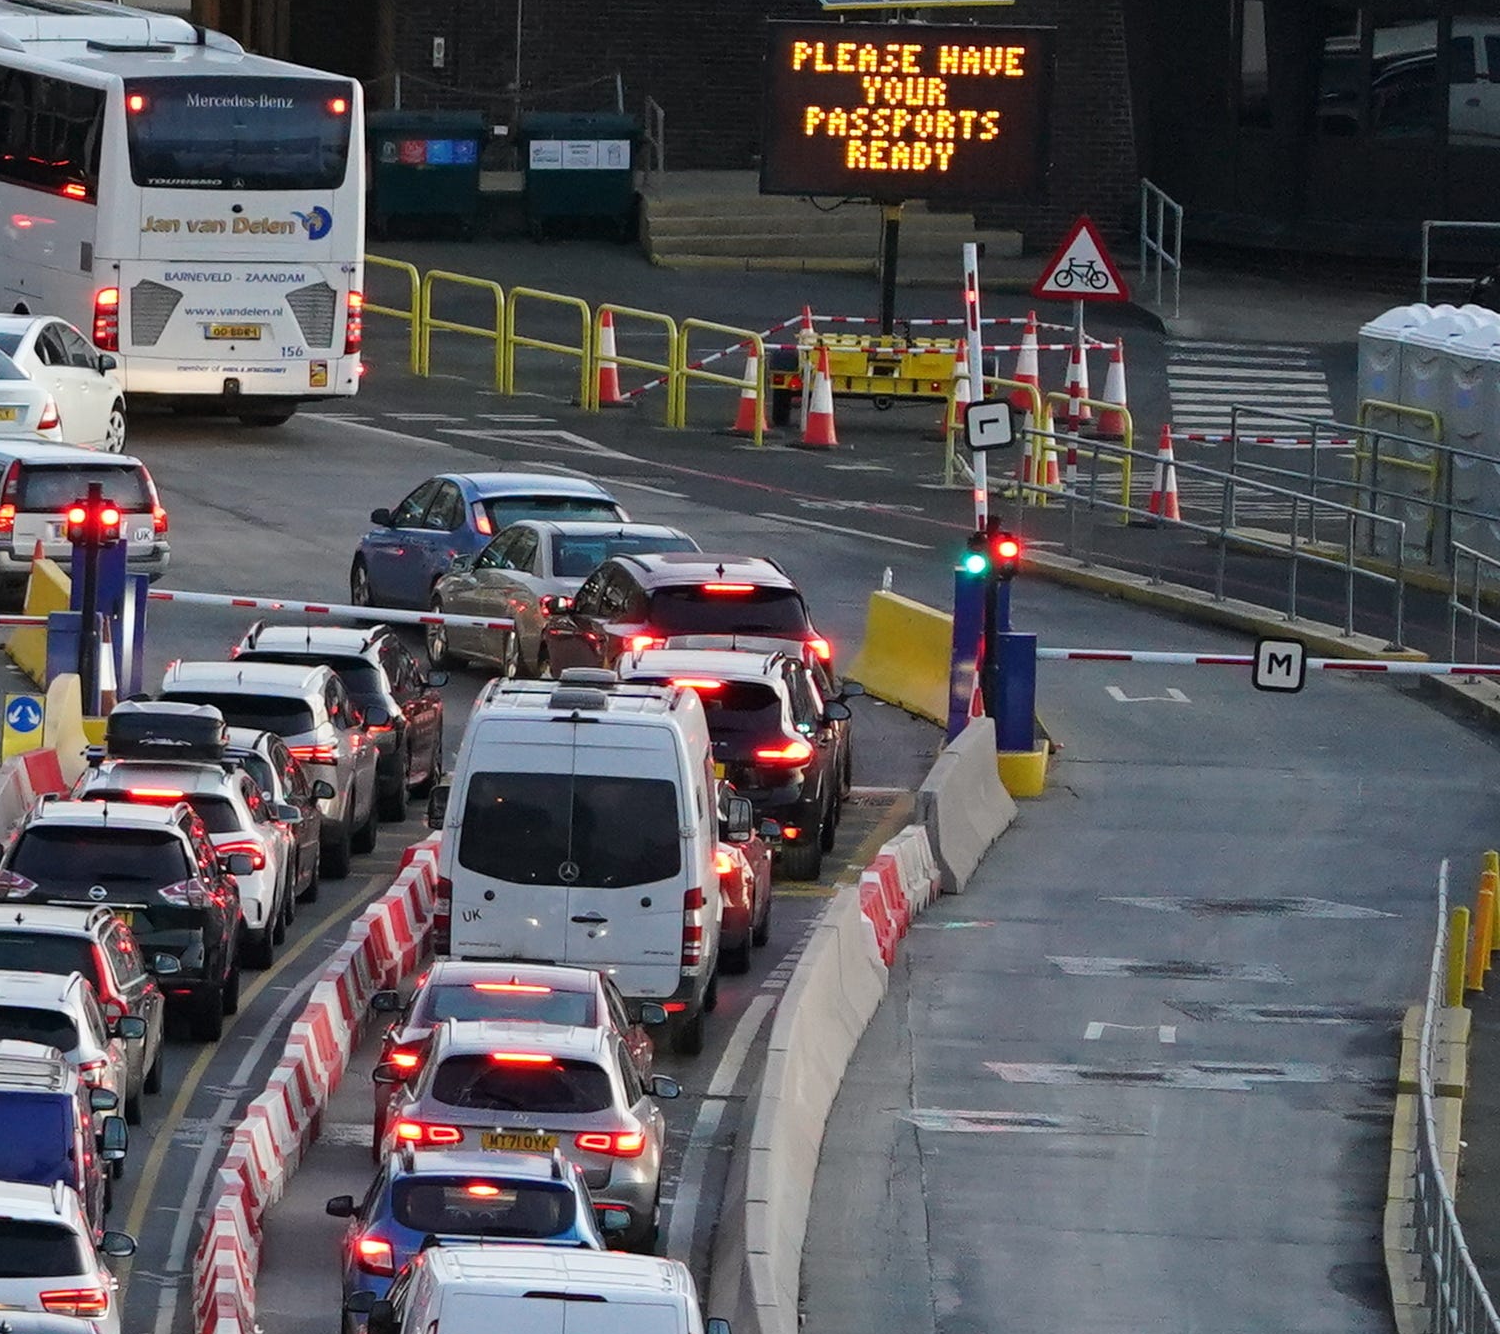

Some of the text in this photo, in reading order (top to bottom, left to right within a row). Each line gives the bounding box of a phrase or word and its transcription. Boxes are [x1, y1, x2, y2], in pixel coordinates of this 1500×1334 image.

[793, 42, 1026, 76] PLEASE HAVE
[863, 76, 947, 106] YOUR
[186, 92, 294, 110] Mercedes-Benz
[805, 107, 999, 140] PASSPORTS
[847, 140, 954, 171] READY
[147, 178, 223, 187] TOURISMO
[141, 214, 295, 236] Jan van Delen
[164, 272, 305, 283] BARNEVELD ZAANDAM
[185, 306, 283, 317] www.vandelen.nl
[281, 346, 304, 357] 156
[136, 530, 150, 541] UK
[1268, 652, 1291, 676] M
[463, 910, 481, 923] UK
